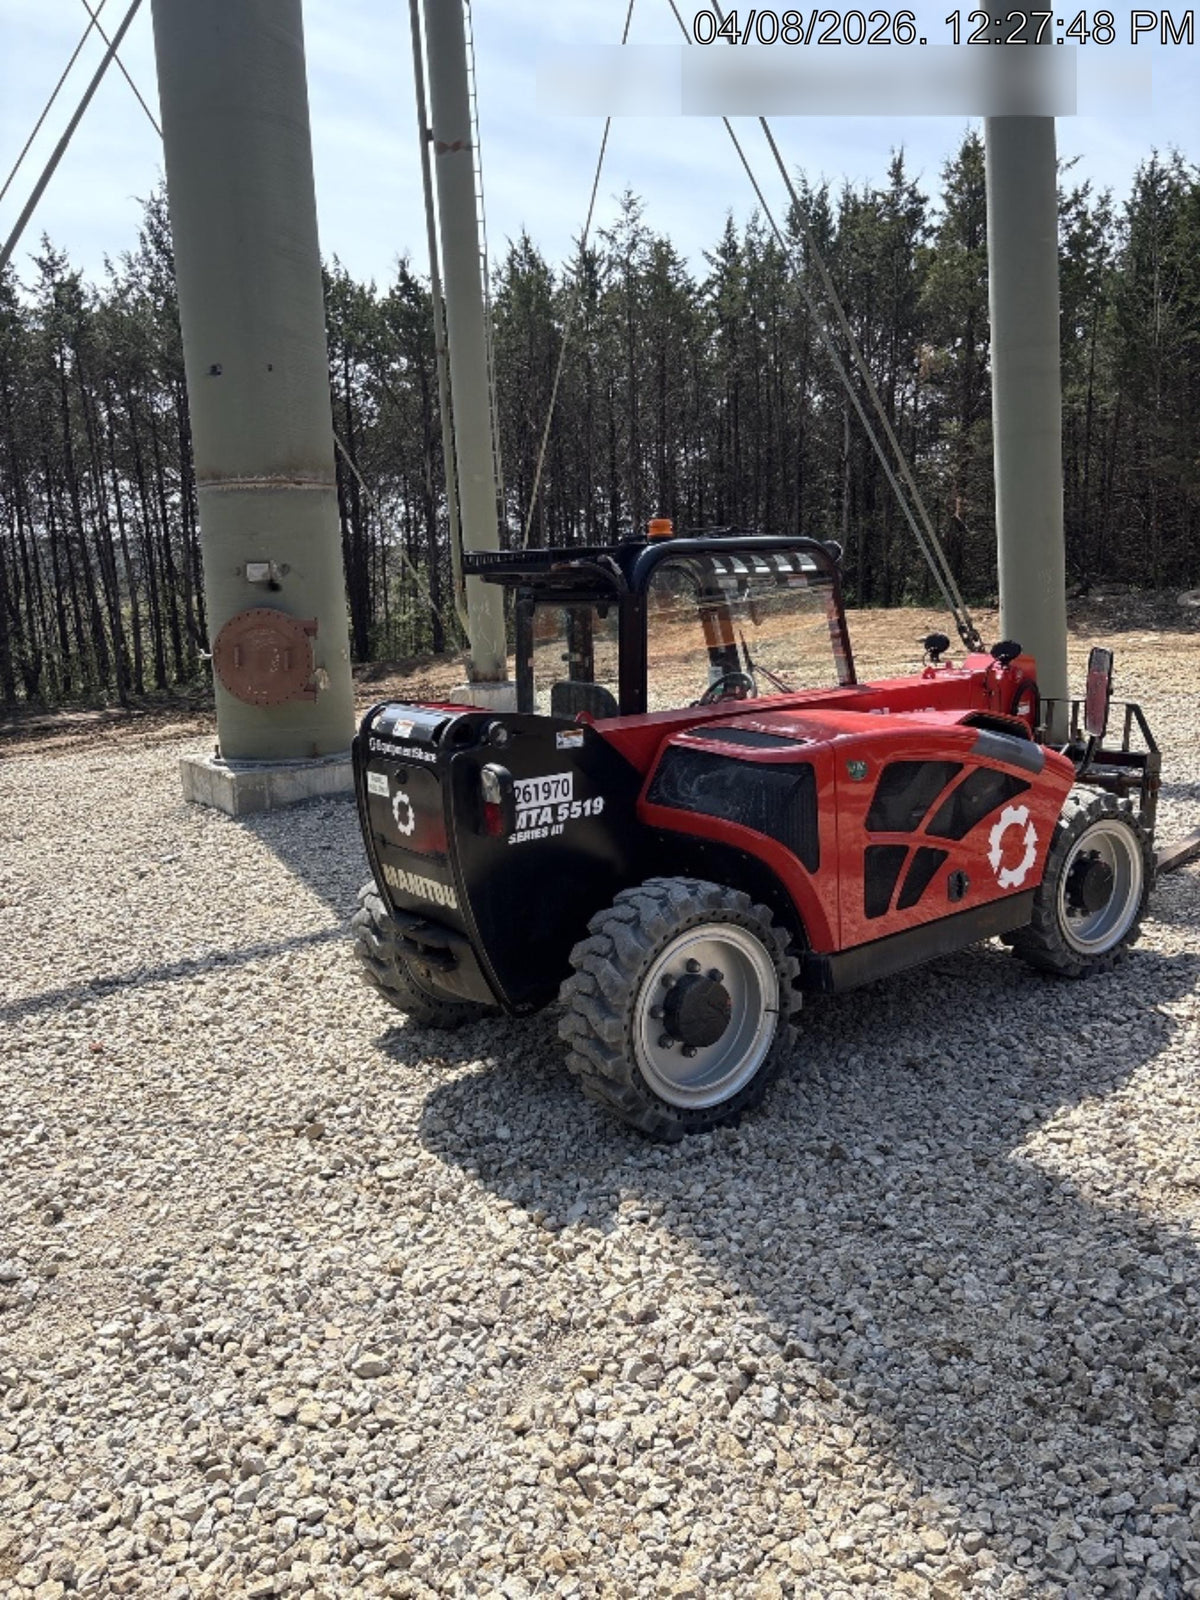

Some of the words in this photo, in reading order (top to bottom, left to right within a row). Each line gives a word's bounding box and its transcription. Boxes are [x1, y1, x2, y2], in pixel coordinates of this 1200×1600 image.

[557, 795, 605, 822] 5519
[508, 826, 549, 845] SERIES
[381, 863, 458, 910] MANITOU
